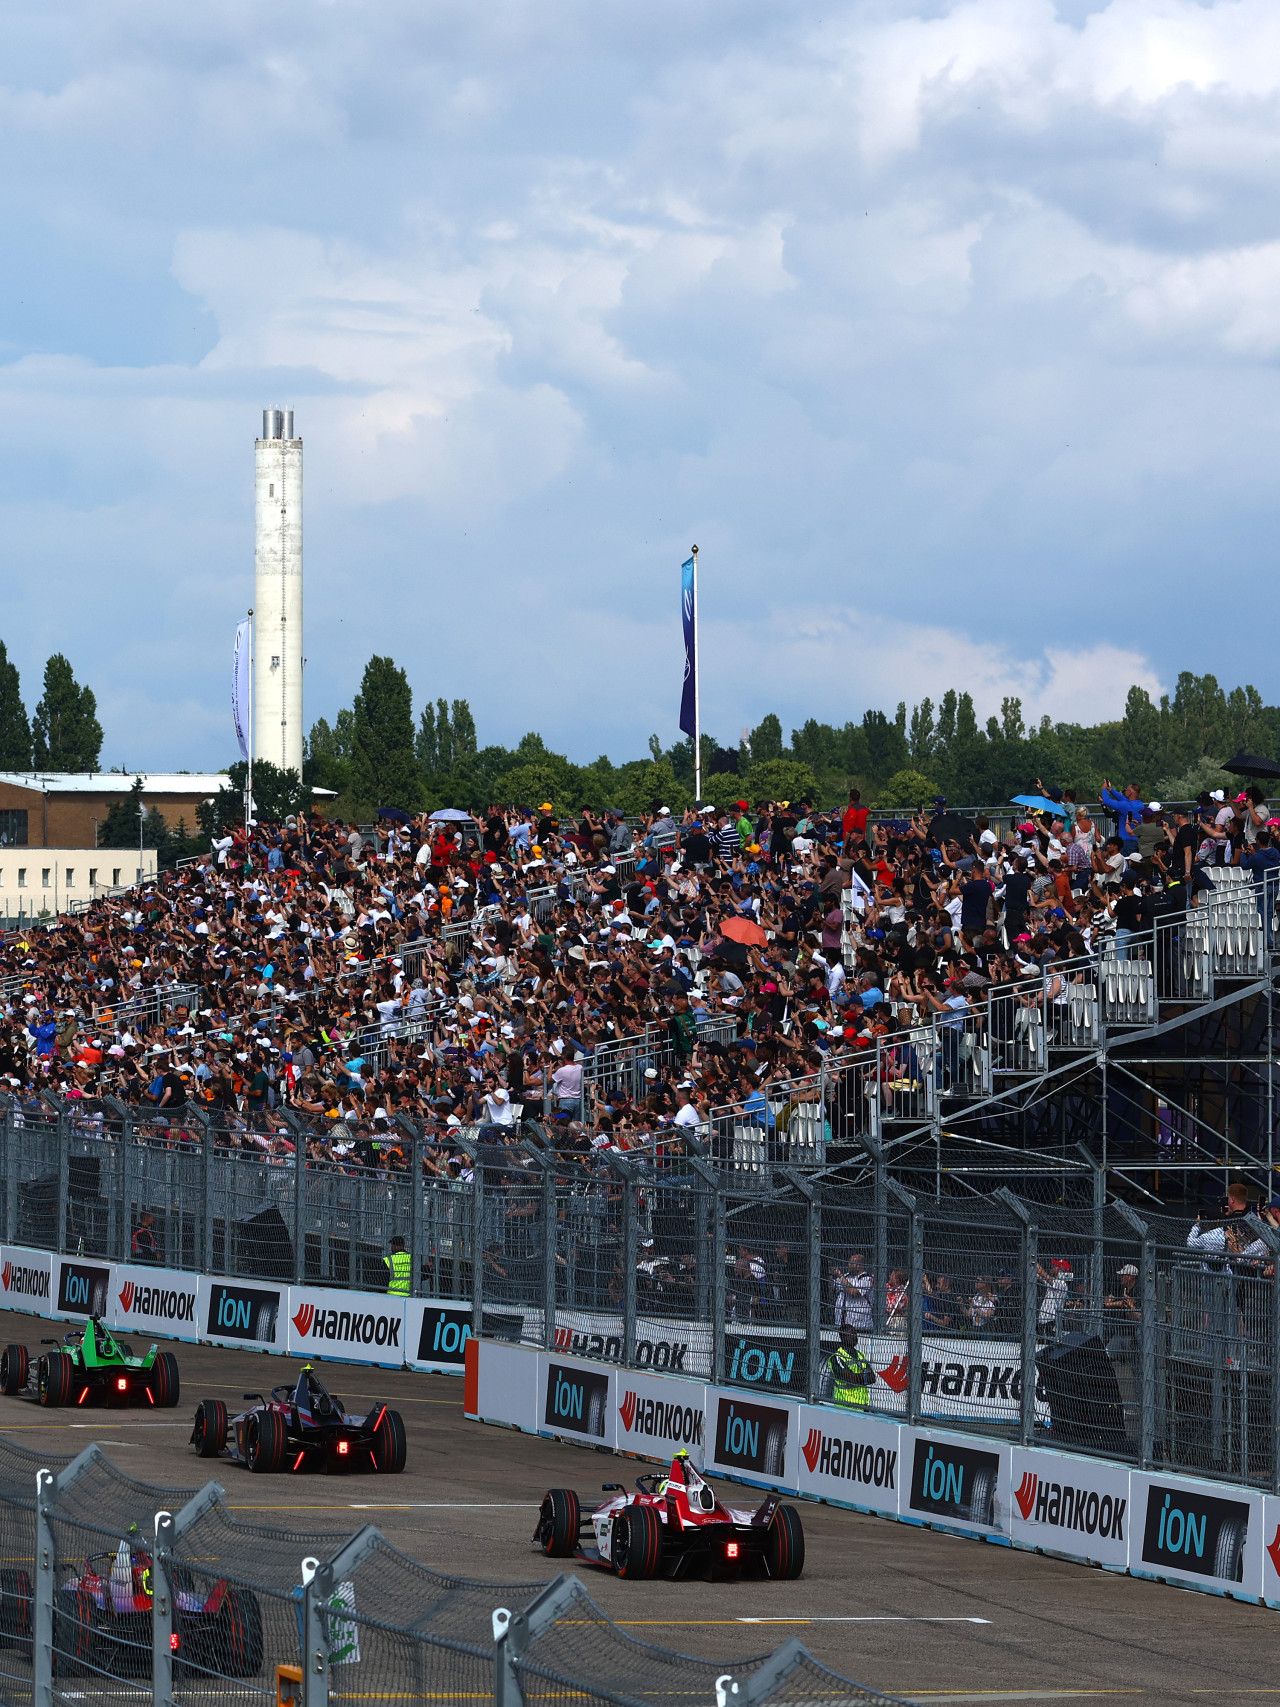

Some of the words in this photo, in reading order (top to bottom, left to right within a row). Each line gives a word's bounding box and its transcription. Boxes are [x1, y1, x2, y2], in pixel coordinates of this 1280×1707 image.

[66, 1267, 90, 1304] iON
[218, 1289, 251, 1329] iON
[730, 1339, 794, 1384] iON
[554, 1370, 584, 1420] iON
[725, 1404, 759, 1458] iON
[923, 1446, 964, 1504] iON
[1157, 1494, 1207, 1558] iON
